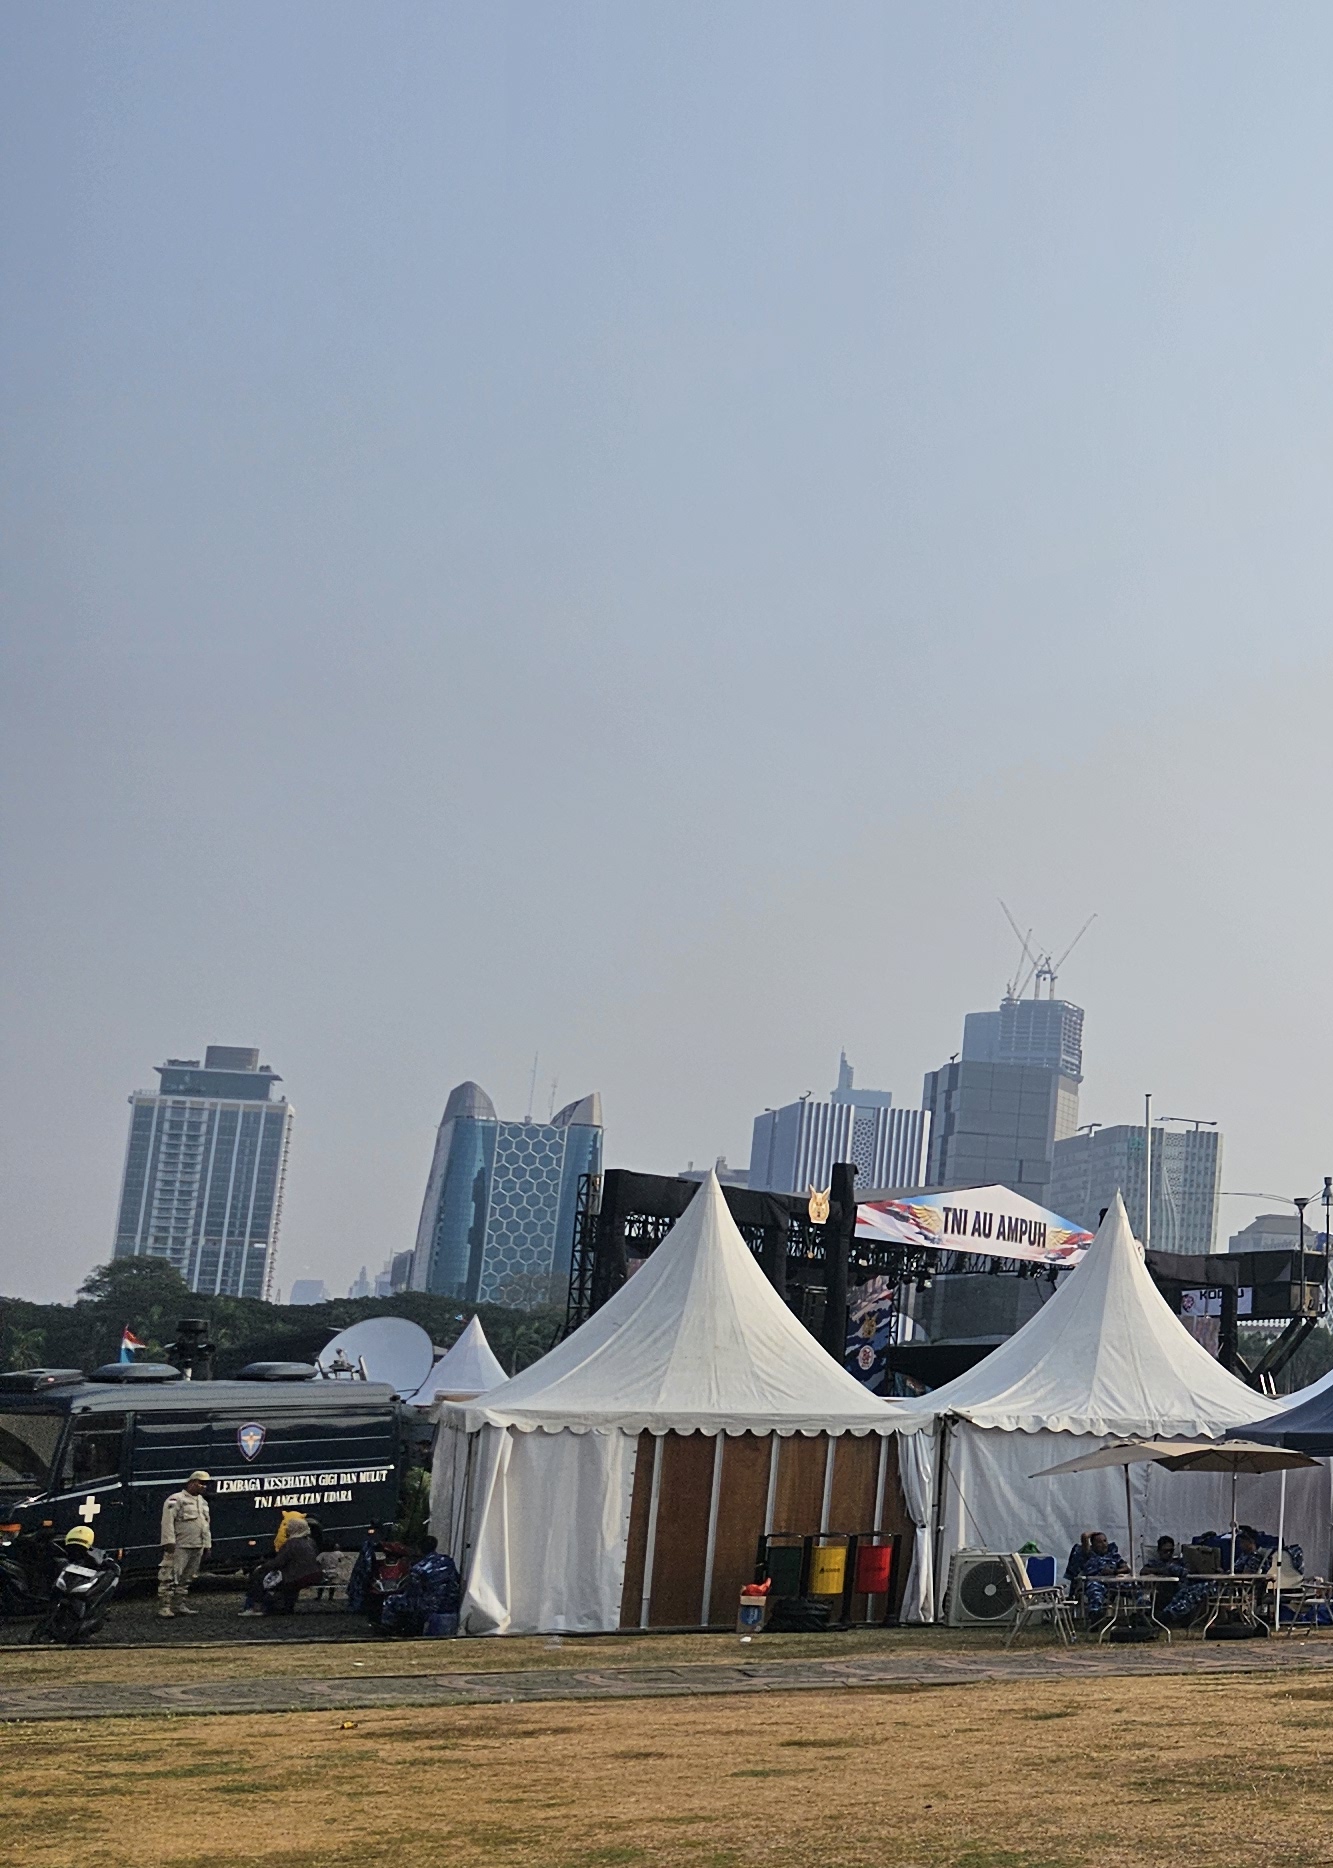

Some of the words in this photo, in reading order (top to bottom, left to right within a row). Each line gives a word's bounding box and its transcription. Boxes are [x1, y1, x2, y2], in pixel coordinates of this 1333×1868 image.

[943, 1206, 968, 1236] TNI
[971, 1210, 993, 1239] AU
[996, 1214, 1047, 1249] AMPUH
[216, 1479, 261, 1493] LEMBAGA
[263, 1475, 317, 1490] KESEHATAN
[318, 1473, 338, 1486] GIGI
[339, 1472, 357, 1485] DAN
[359, 1470, 388, 1483] MULUT
[254, 1496, 272, 1509] TNI
[274, 1492, 322, 1507] ANGKATAN
[323, 1490, 353, 1503] UDARA
